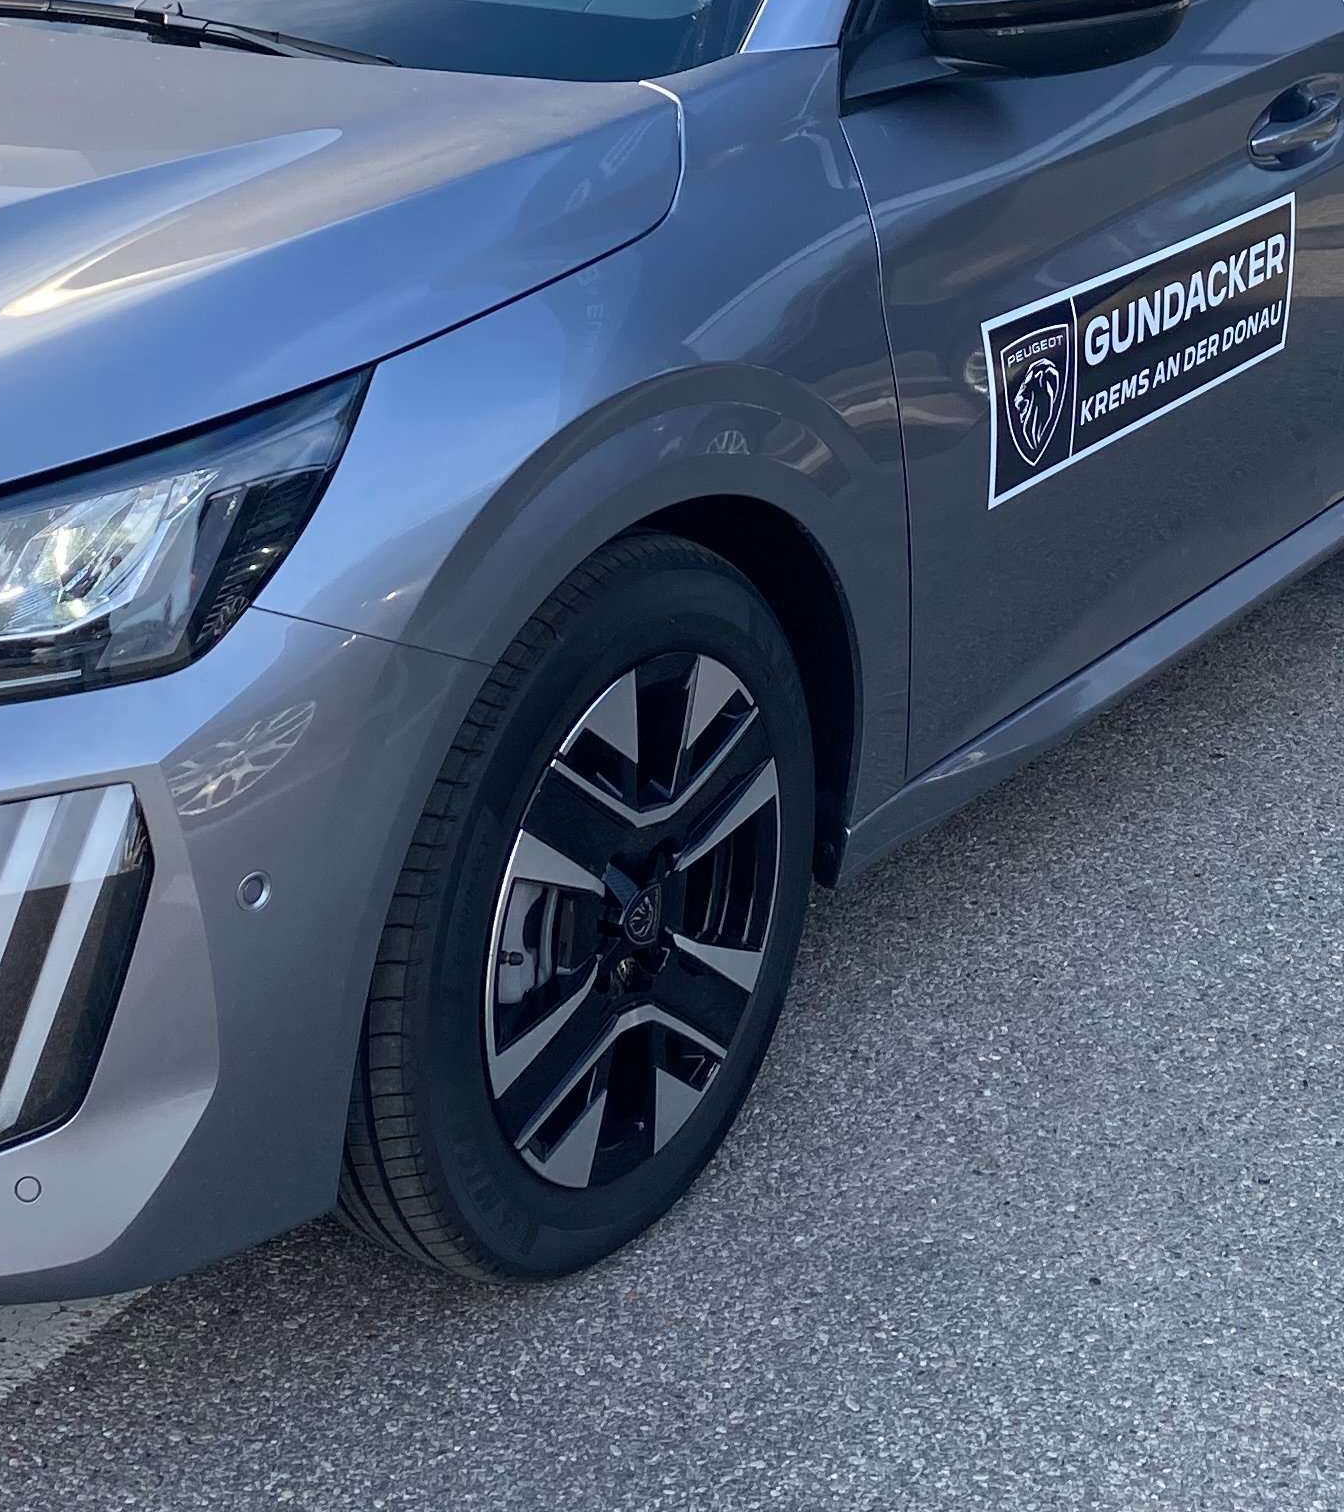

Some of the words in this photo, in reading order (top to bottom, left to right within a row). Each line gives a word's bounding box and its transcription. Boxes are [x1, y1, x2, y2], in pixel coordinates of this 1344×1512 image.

[1007, 335, 1064, 368] PEUGEOT
[1084, 233, 1286, 366] GUNDACKER
[1079, 368, 1150, 426] KREMS
[1152, 356, 1180, 389] AN
[1183, 333, 1219, 372] DER
[1222, 300, 1282, 354] DONAU
